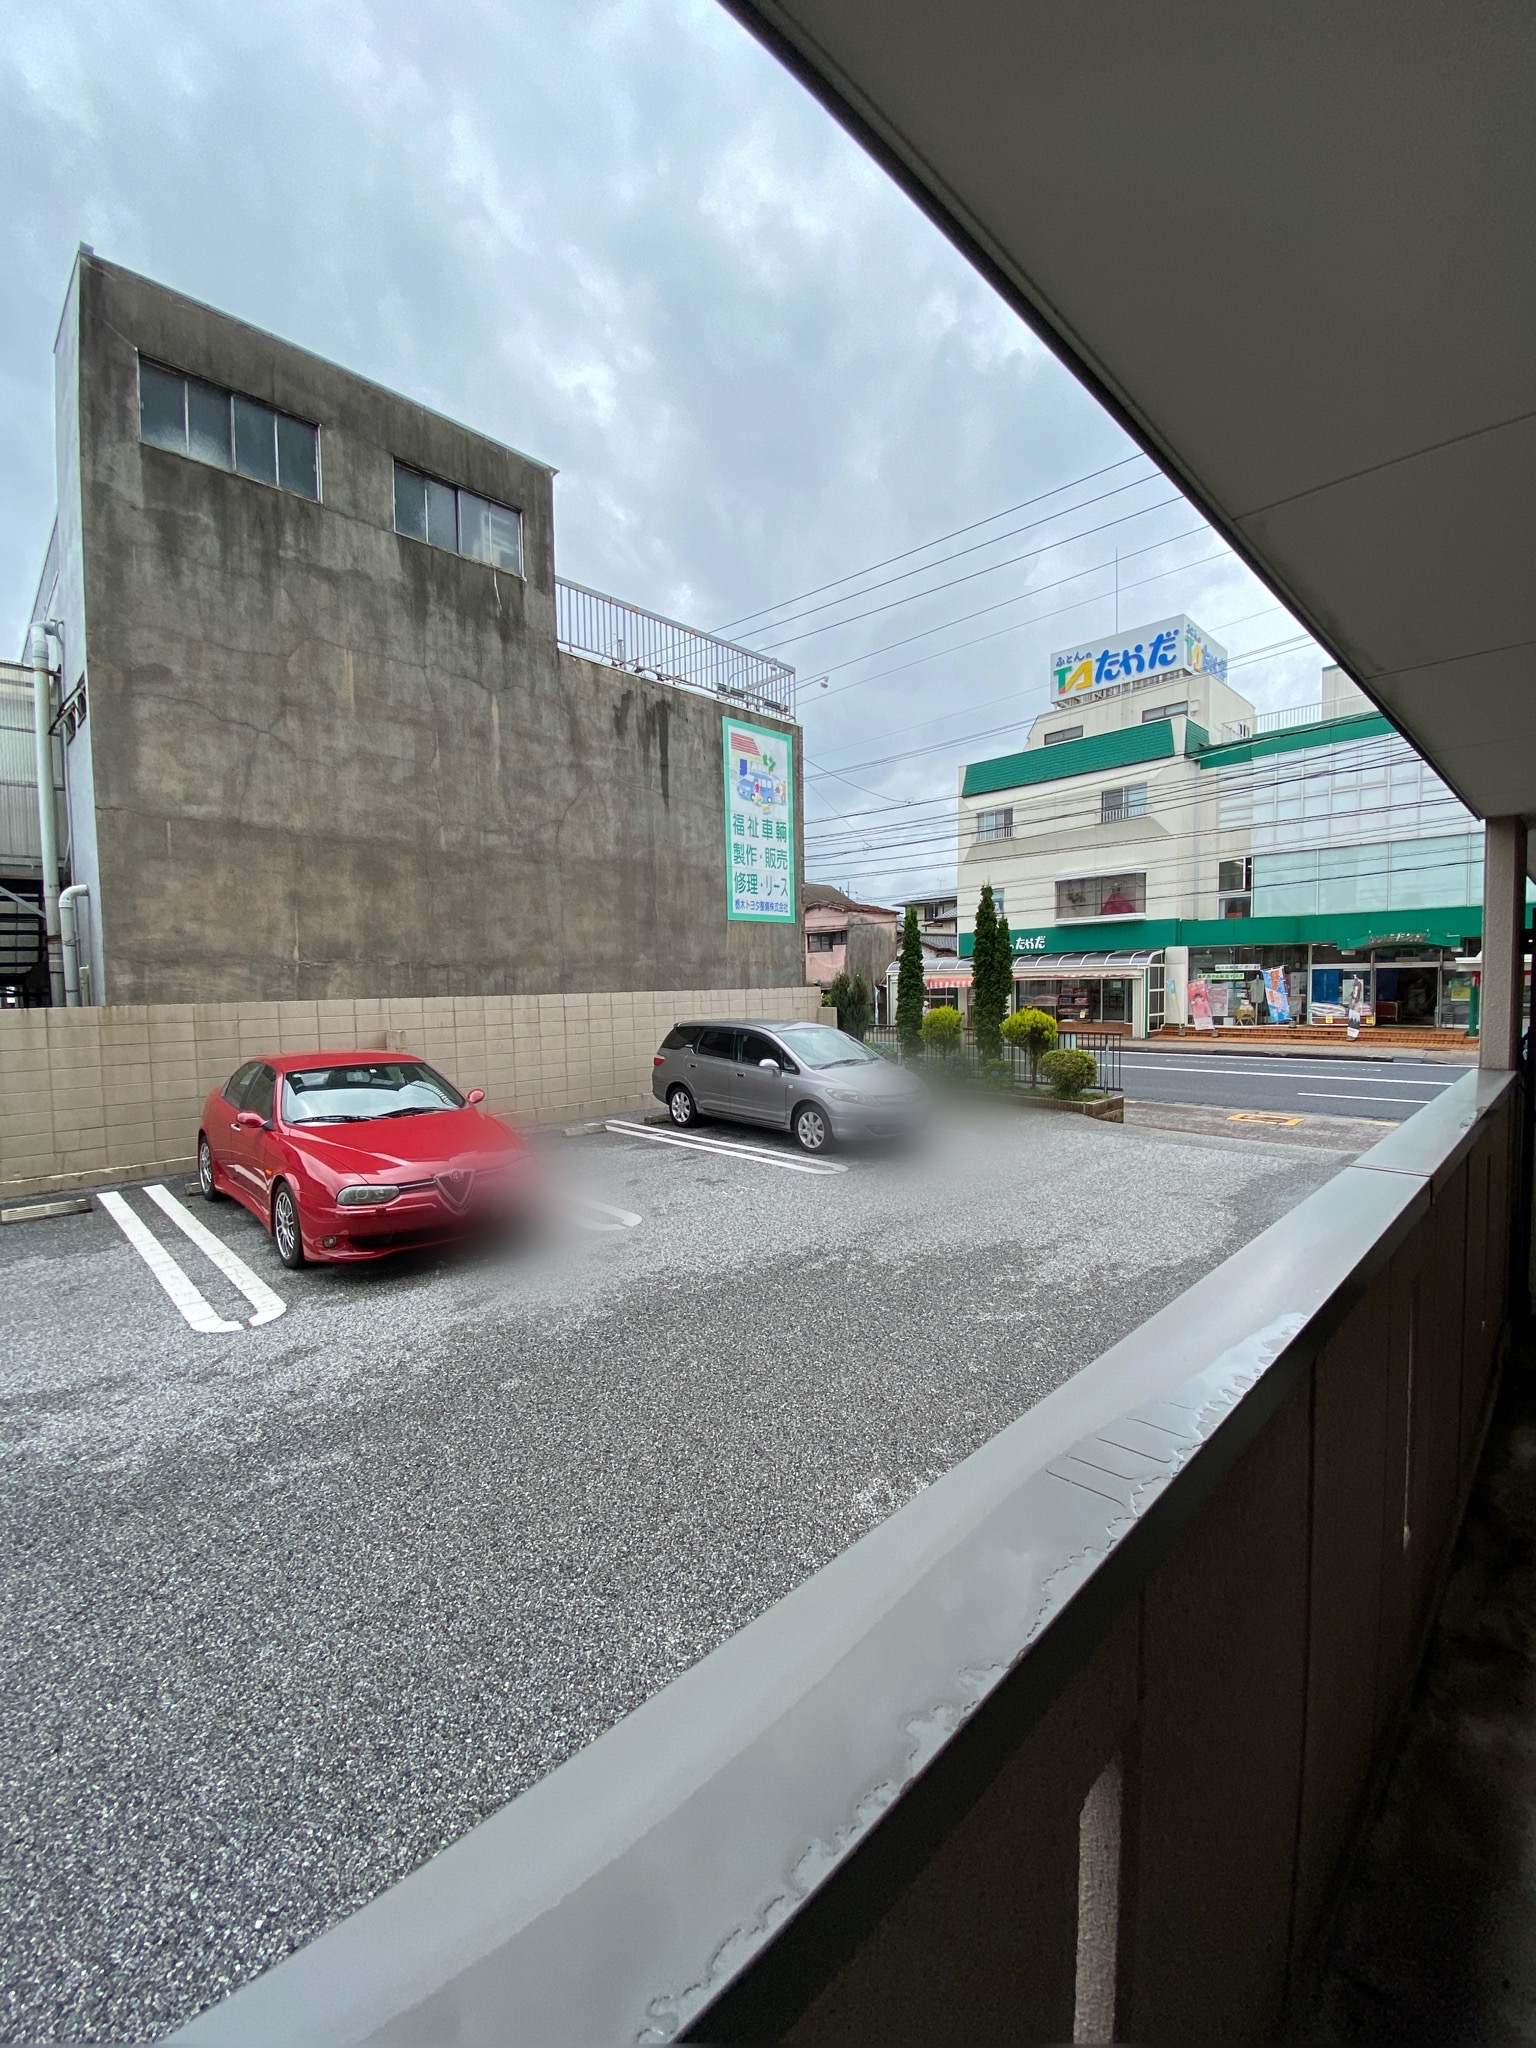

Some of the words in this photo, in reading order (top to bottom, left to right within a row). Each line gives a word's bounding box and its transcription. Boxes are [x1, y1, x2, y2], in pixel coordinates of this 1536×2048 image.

[1056, 651, 1092, 667] ふとんの
[733, 843, 788, 870] 製作・販売
[734, 871, 788, 897] 修理・リース
[735, 899, 788, 913] 栃木トヨタ整備株式会社
